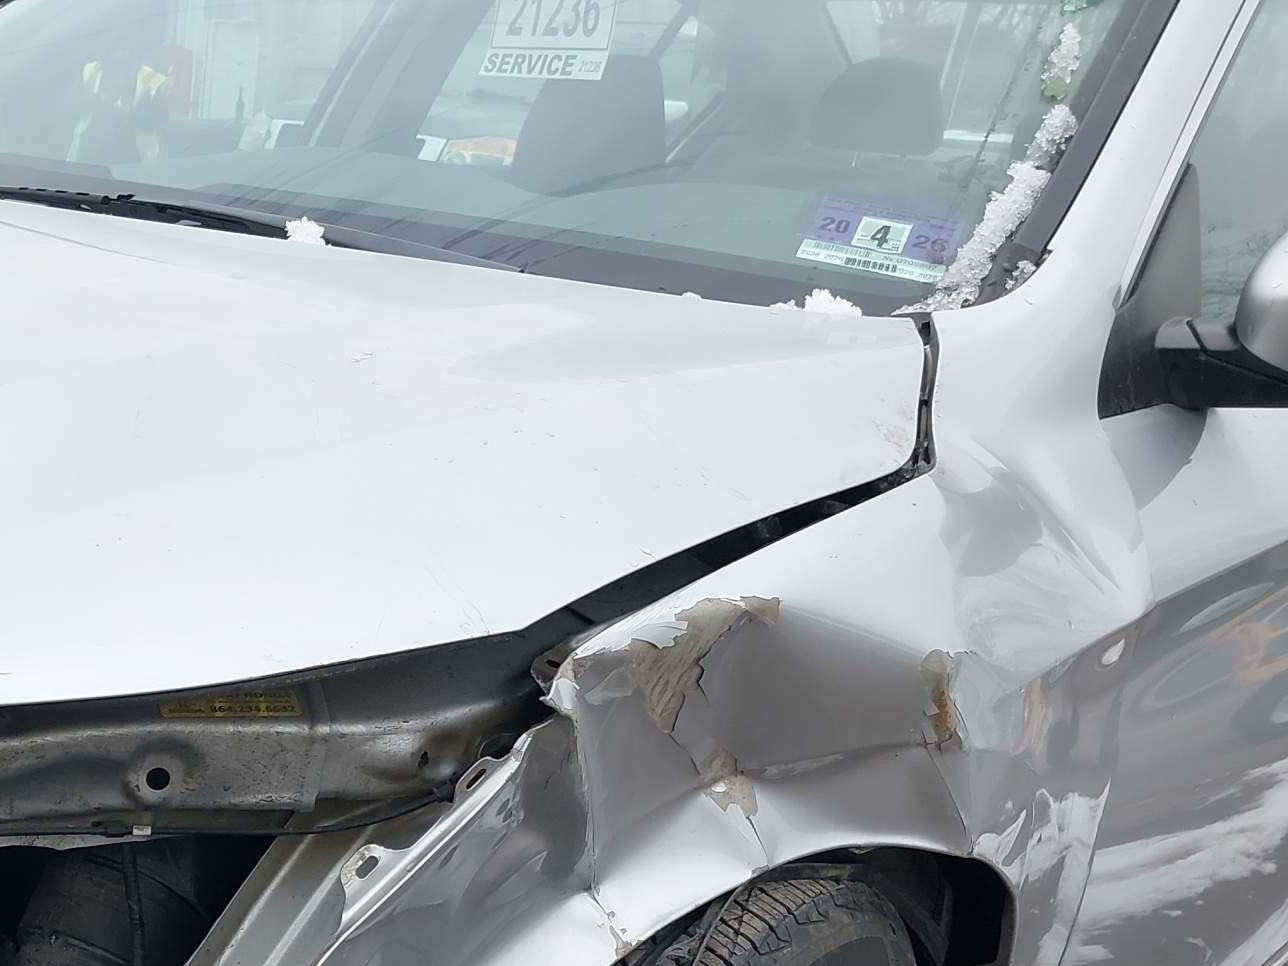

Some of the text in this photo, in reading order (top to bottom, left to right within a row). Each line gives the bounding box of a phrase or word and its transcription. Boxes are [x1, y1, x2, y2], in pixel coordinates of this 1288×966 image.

[506, 0, 600, 37] 21236
[483, 53, 577, 76] SERVICE
[818, 216, 851, 234] 20
[870, 225, 892, 249] 4
[912, 234, 949, 253] 26
